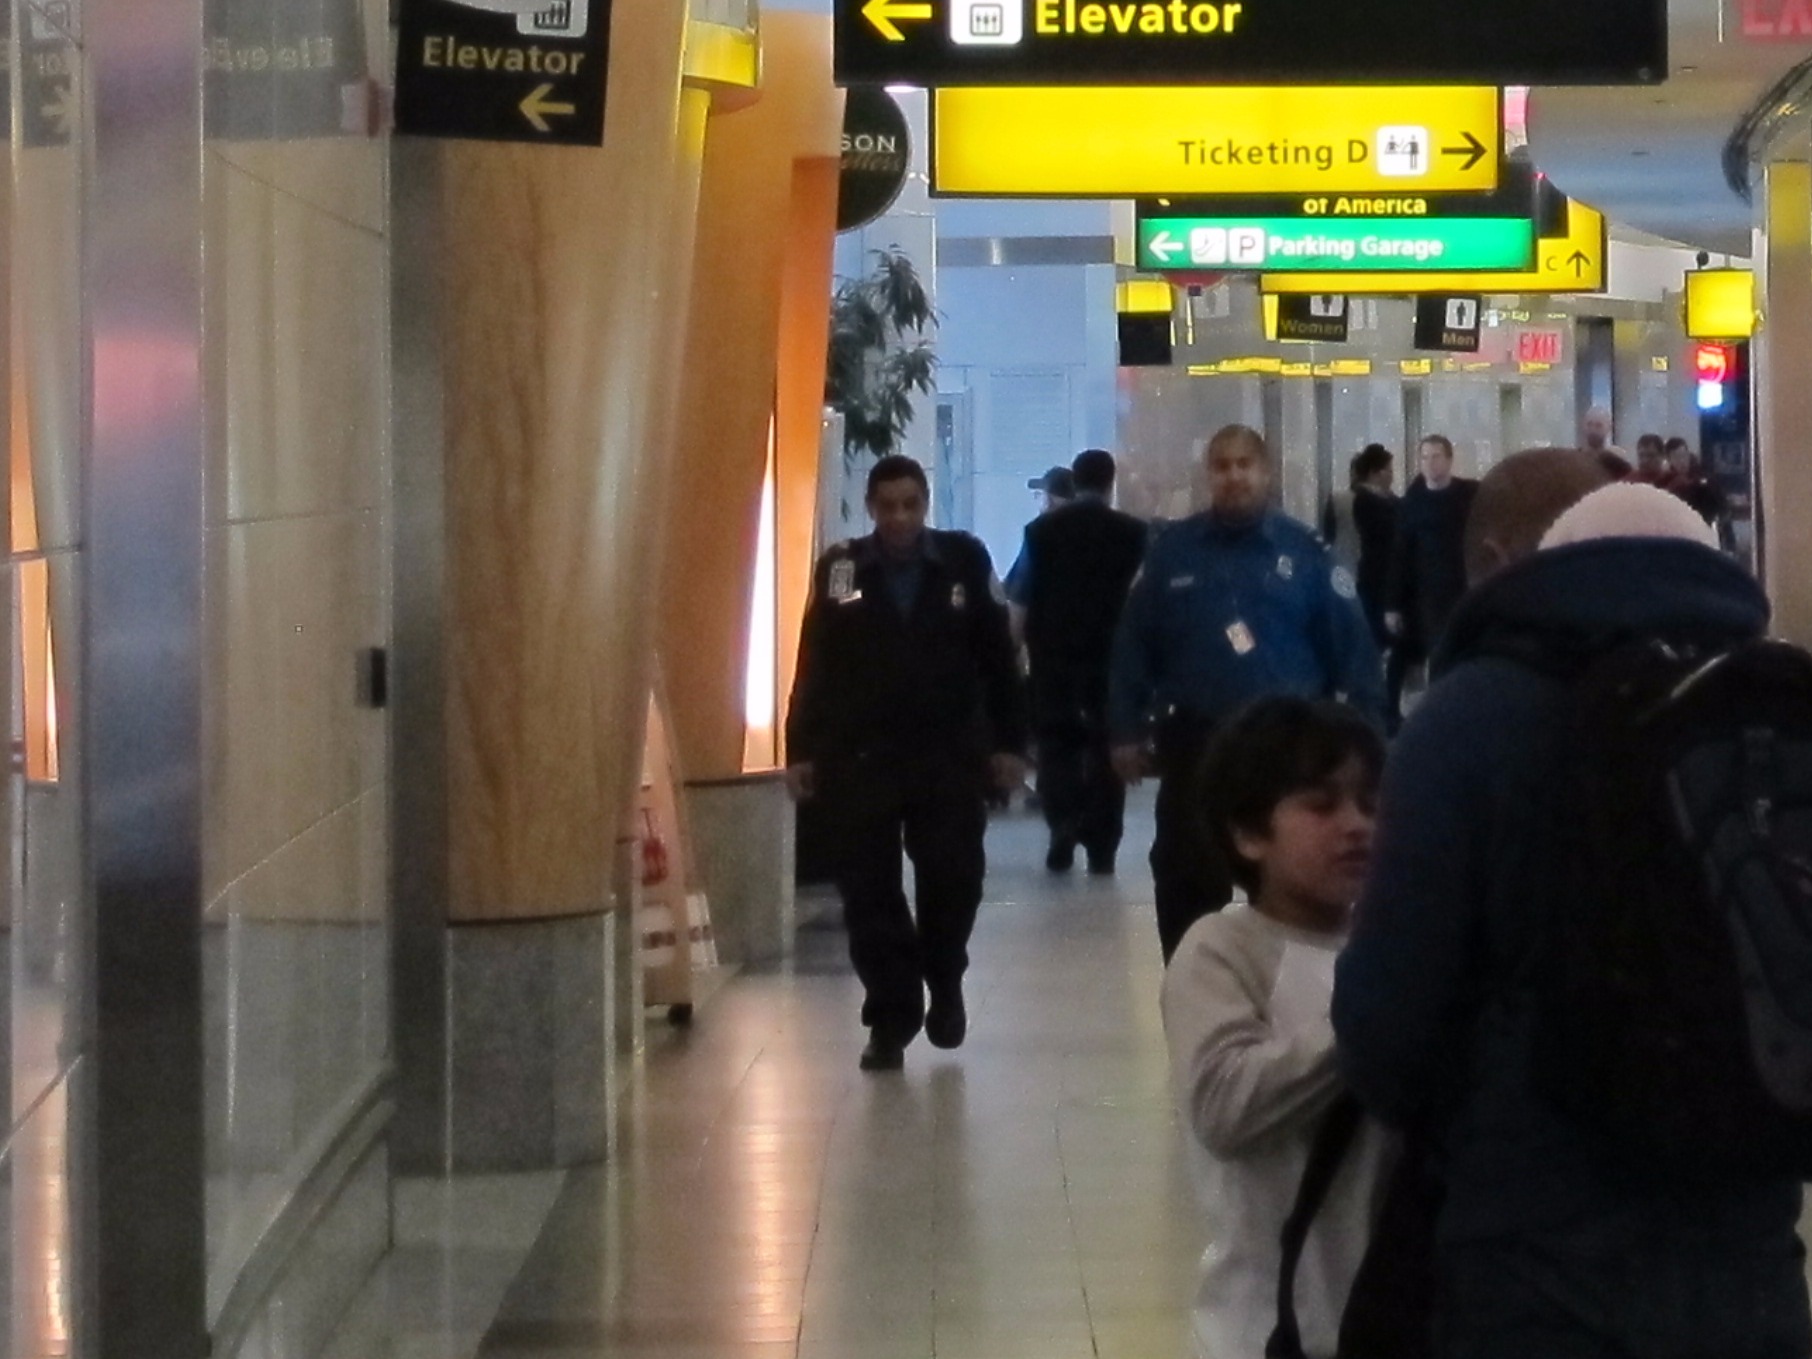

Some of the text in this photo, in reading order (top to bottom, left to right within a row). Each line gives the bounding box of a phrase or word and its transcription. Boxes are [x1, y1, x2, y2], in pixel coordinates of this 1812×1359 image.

[422, 37, 586, 76] Elevator
[1178, 138, 1369, 171] Ticketing D
[1333, 196, 1427, 215] America
[1268, 234, 1356, 261] Parking
[1360, 235, 1444, 261] Garage
[1280, 319, 1345, 336] Women
[1441, 331, 1477, 347] Men
[1520, 332, 1558, 360] EXIT
